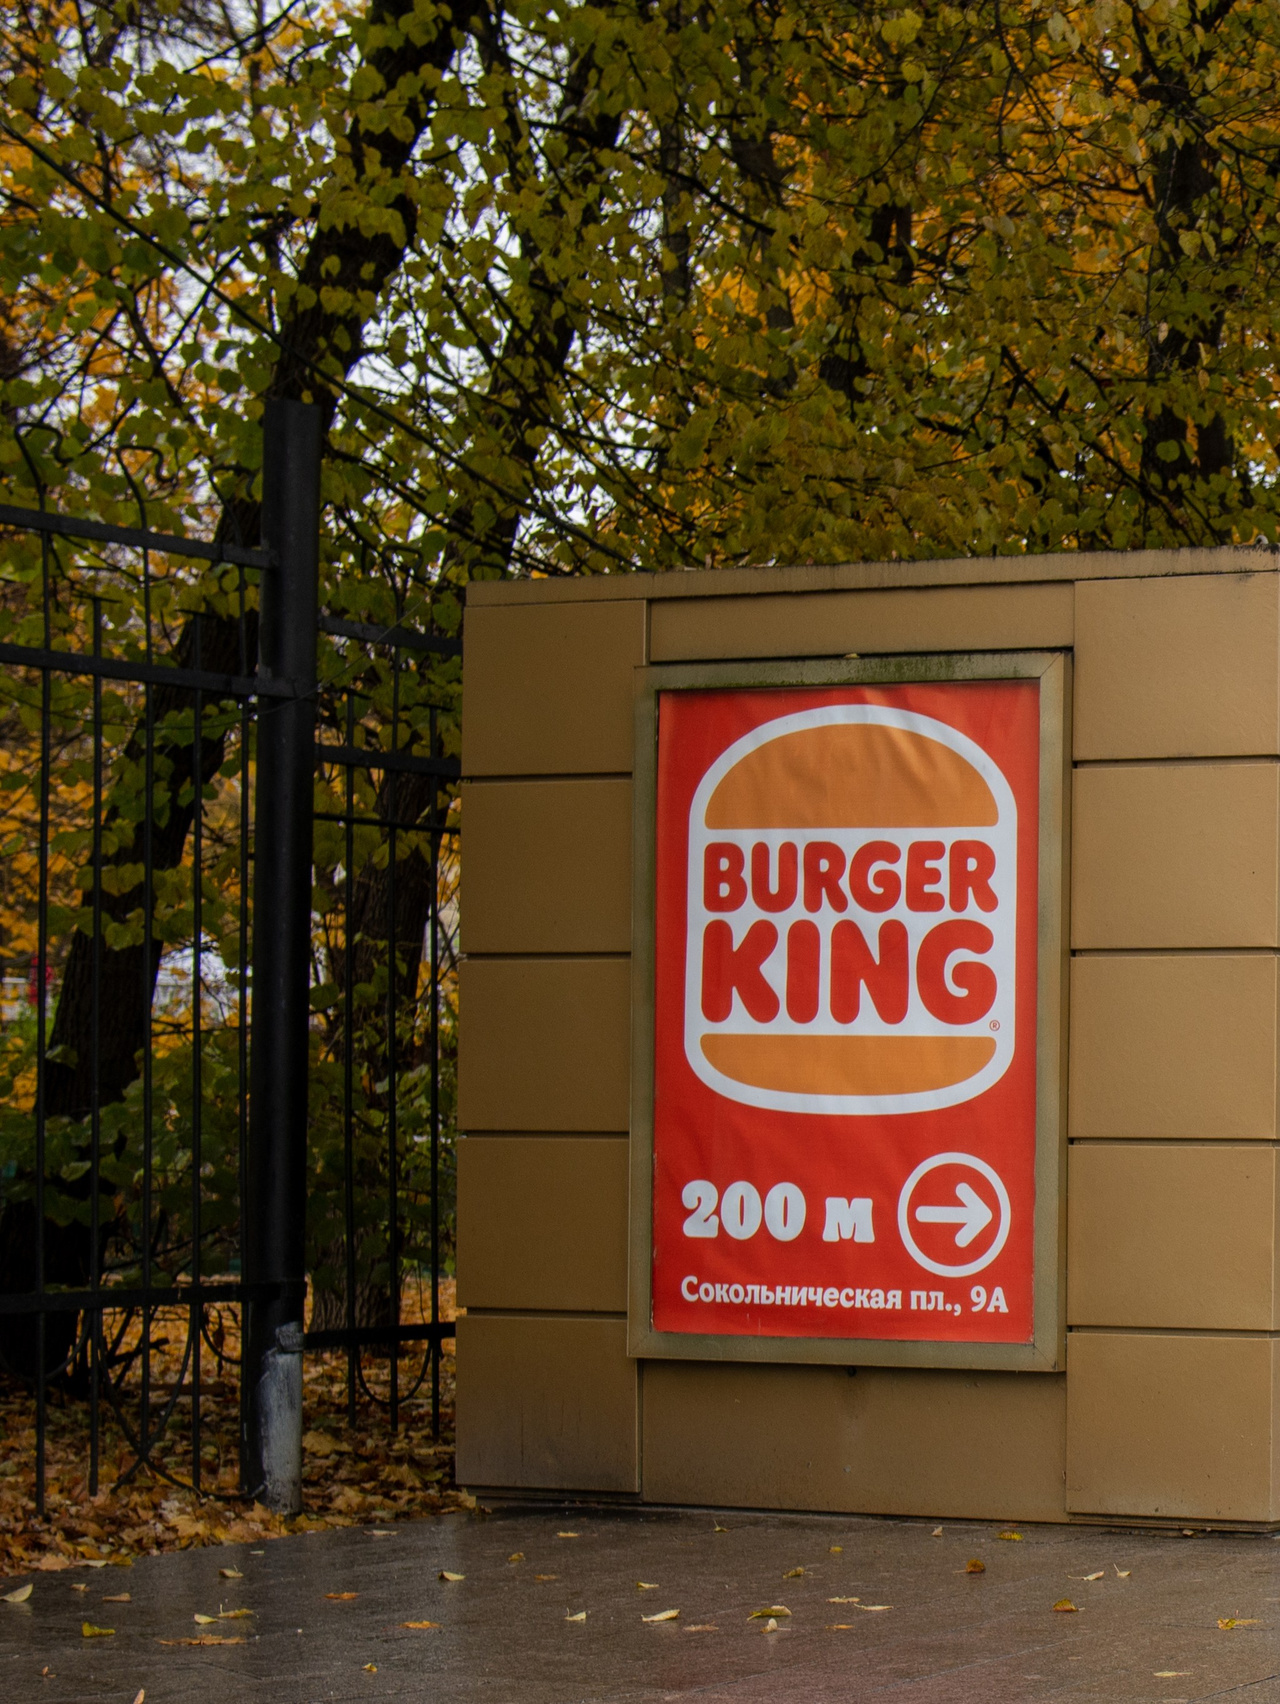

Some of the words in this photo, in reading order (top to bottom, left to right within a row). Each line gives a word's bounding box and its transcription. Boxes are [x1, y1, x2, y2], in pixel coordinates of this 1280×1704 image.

[703, 840, 999, 913] BURGER
[701, 919, 998, 1025] KING
[682, 1179, 806, 1242] 200
[822, 1197, 875, 1243] м
[681, 1275, 902, 1309] Сокольническая
[910, 1290, 962, 1316] пл.,
[970, 1285, 1009, 1313] 9А
